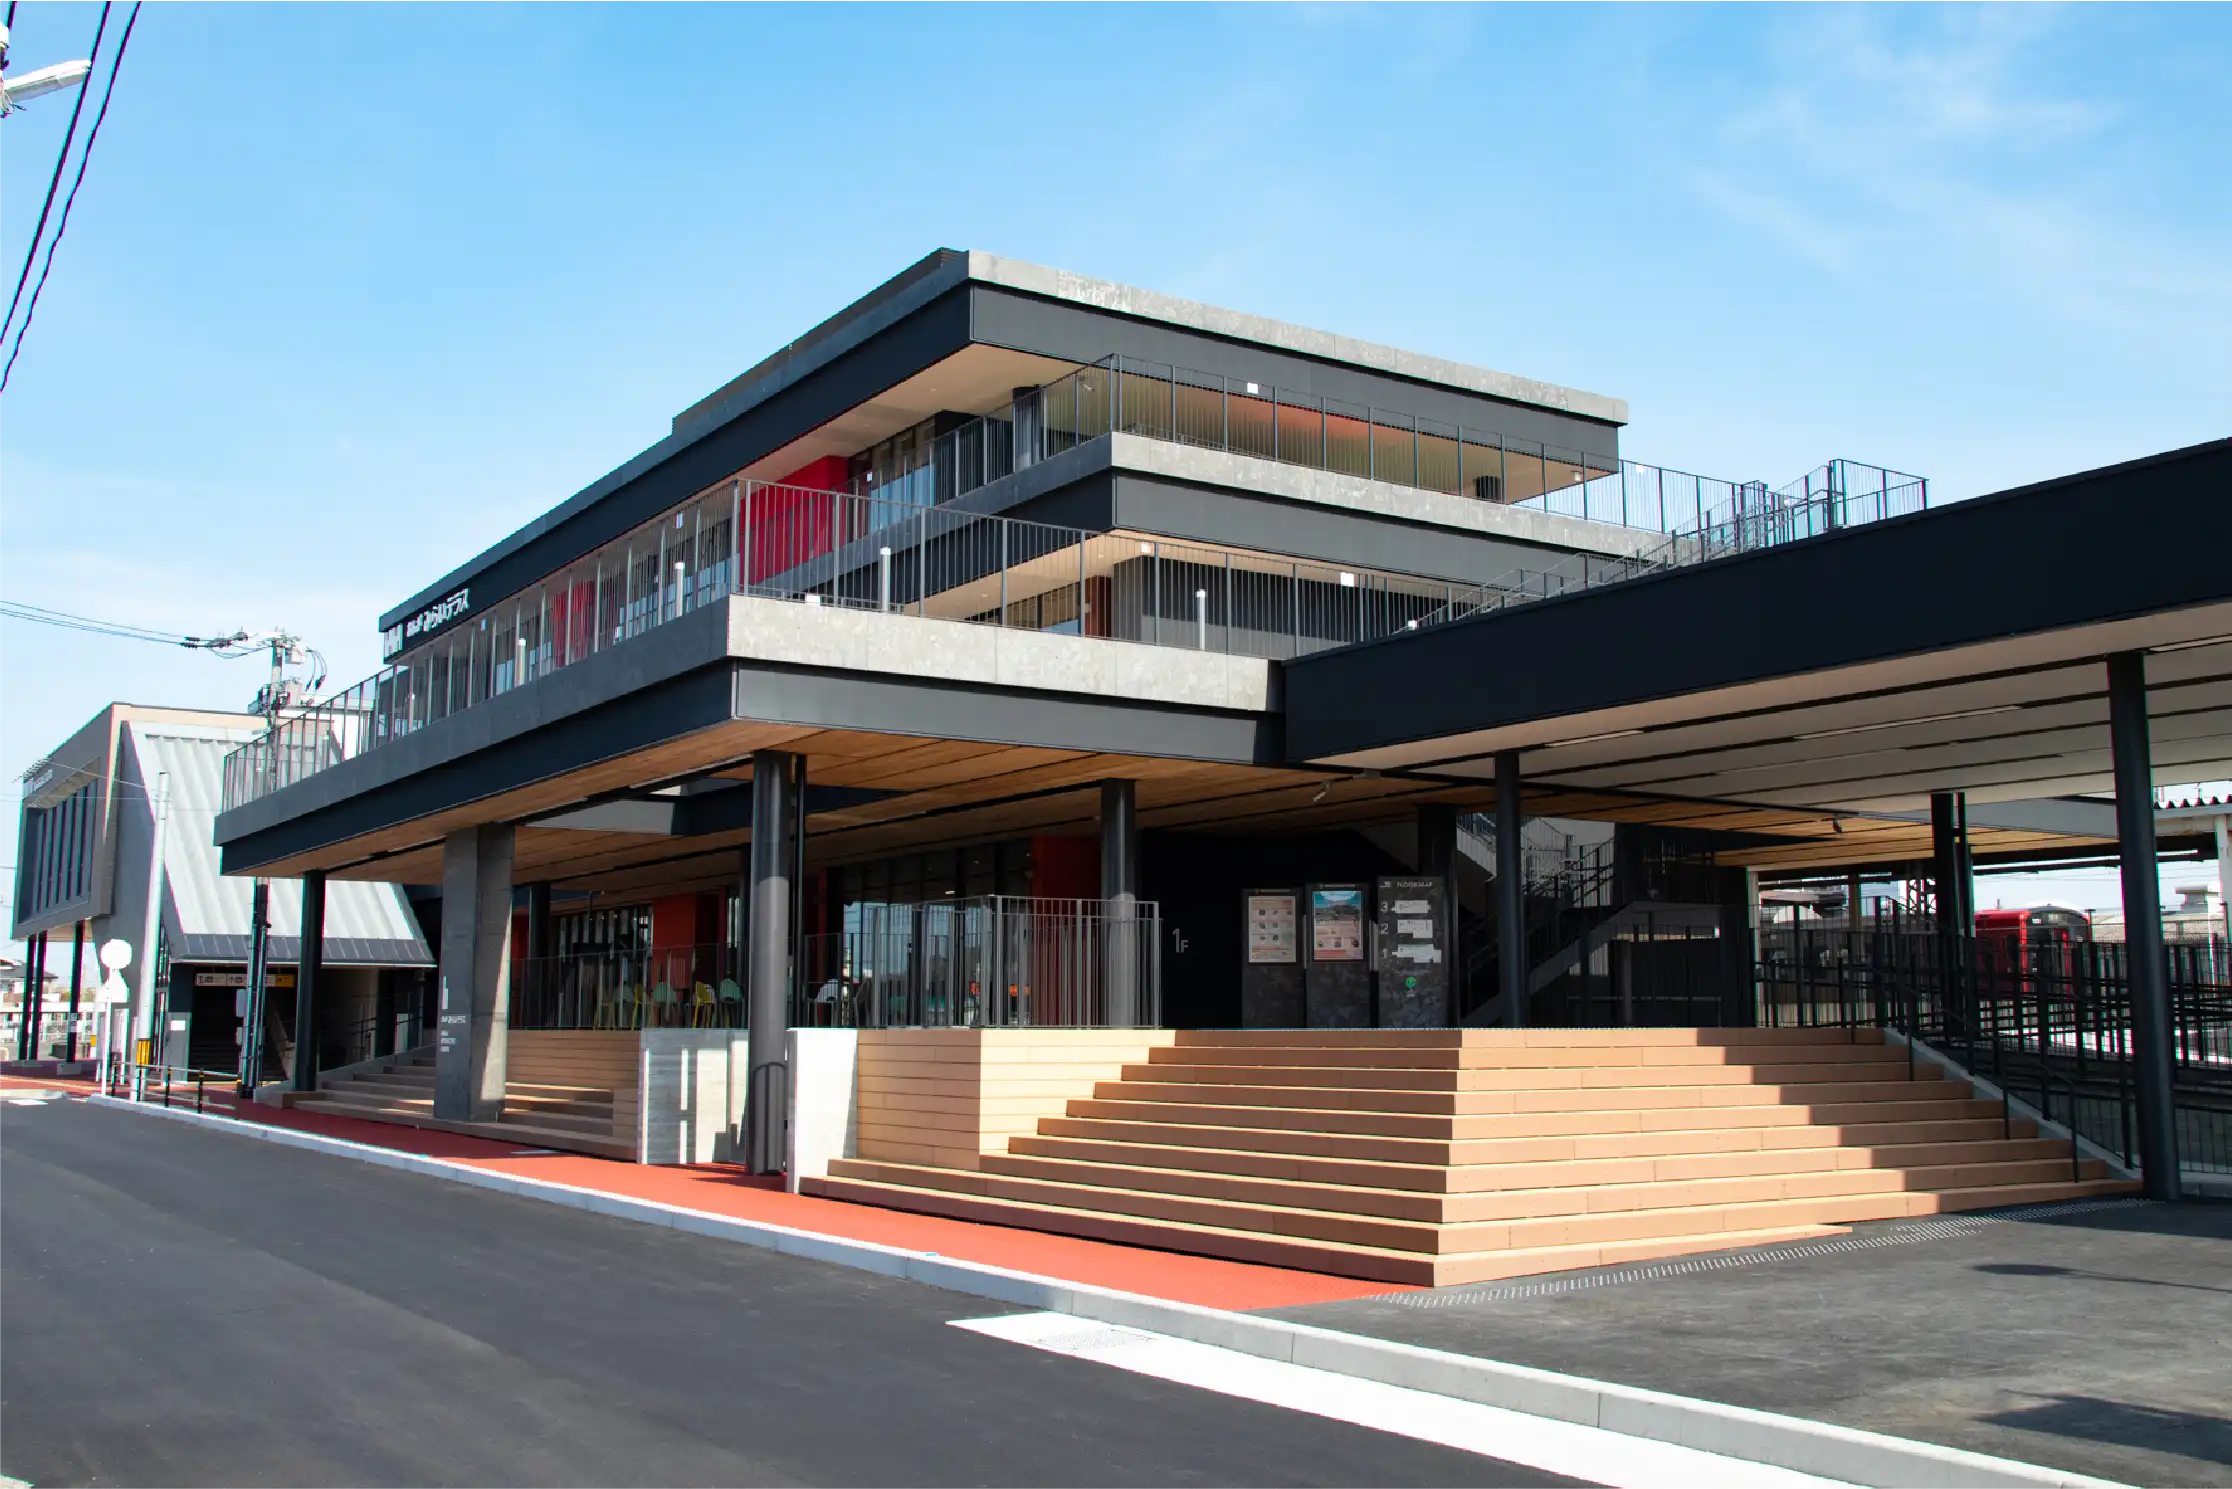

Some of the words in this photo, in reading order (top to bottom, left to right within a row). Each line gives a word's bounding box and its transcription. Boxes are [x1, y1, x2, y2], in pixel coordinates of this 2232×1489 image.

[1380, 923, 1389, 935] 2
[1172, 928, 1189, 953] 1F
[1382, 948, 1389, 959] 1
